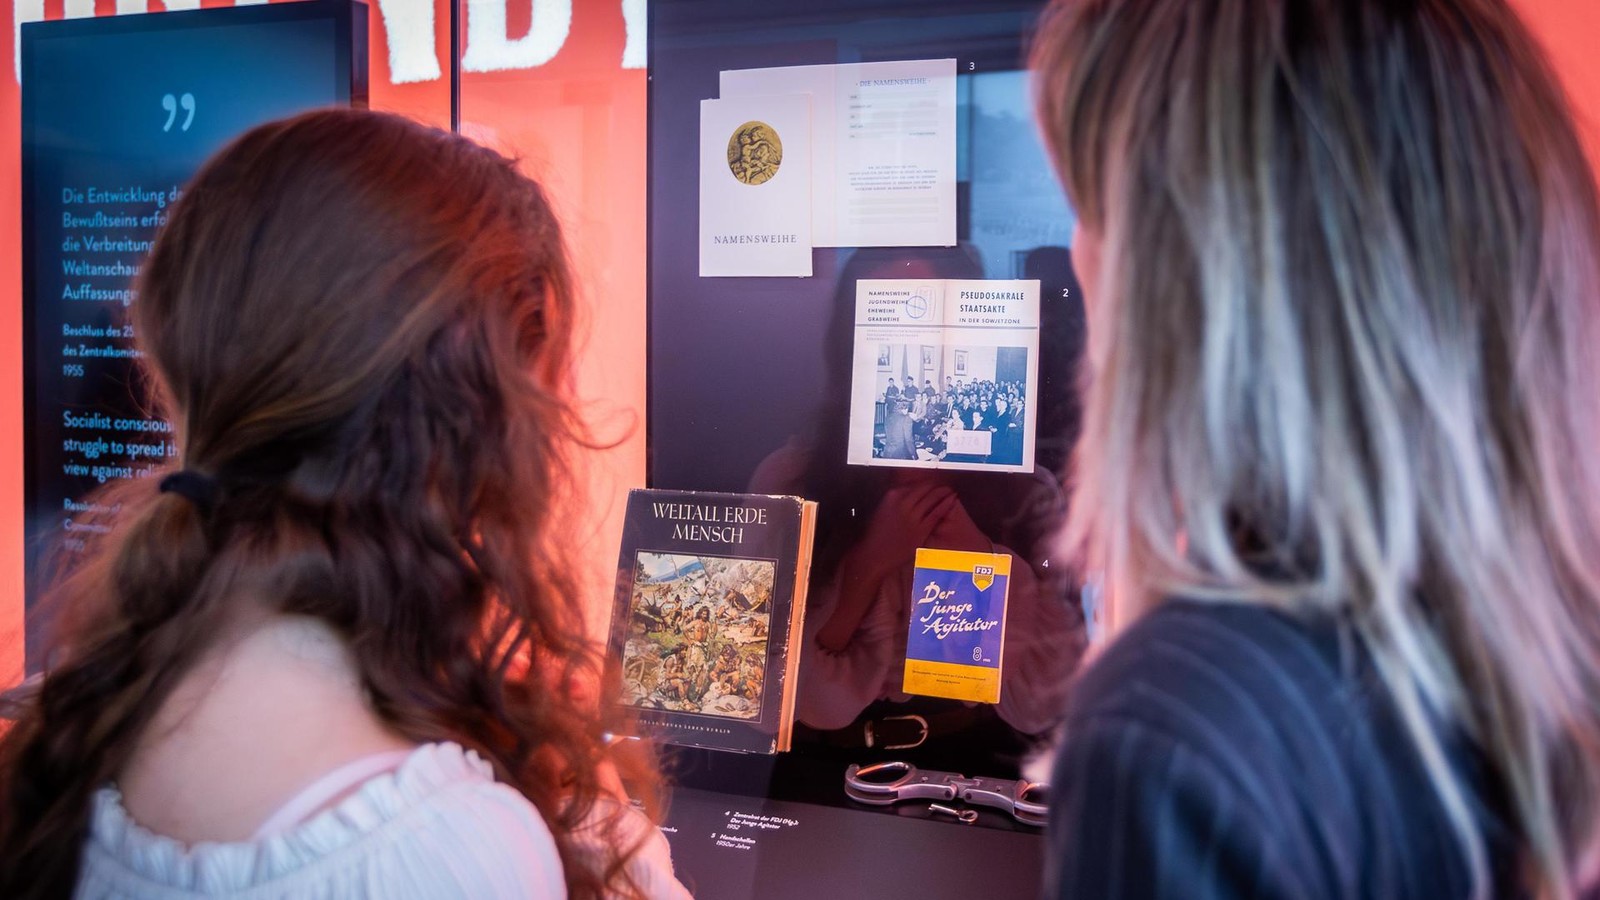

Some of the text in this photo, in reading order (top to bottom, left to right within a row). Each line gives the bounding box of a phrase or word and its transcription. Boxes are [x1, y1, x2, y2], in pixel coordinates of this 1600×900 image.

[969, 62, 975, 71] 3
[873, 77, 927, 87] NAMENSWEIHE
[62, 187, 84, 204] Die
[87, 187, 166, 208] Entwicklung
[63, 211, 138, 228] Bewußtseins
[62, 236, 80, 252] die
[714, 234, 798, 244] NAMENSWEIHE
[960, 291, 1025, 300] PSEUDOSAKRALE
[1062, 288, 1069, 298] 2
[960, 304, 1005, 313] STAATSAKTE
[63, 323, 104, 337] Beschluss
[106, 325, 121, 337] des
[63, 344, 77, 356] des
[63, 364, 84, 377] 1955
[63, 410, 111, 430] Socialist
[63, 437, 109, 459] struggle
[110, 441, 124, 454] to
[126, 440, 165, 460] spread
[63, 459, 89, 476] view
[92, 461, 133, 483] against
[653, 502, 767, 525] WELTALL ERDE
[851, 508, 856, 517] 1
[672, 523, 744, 543] MENSCH
[975, 566, 992, 575] FDJ
[1042, 559, 1049, 568] 4
[917, 581, 955, 604] Der
[920, 601, 973, 622] junge
[922, 617, 998, 639] Agitator
[973, 646, 982, 661] 8
